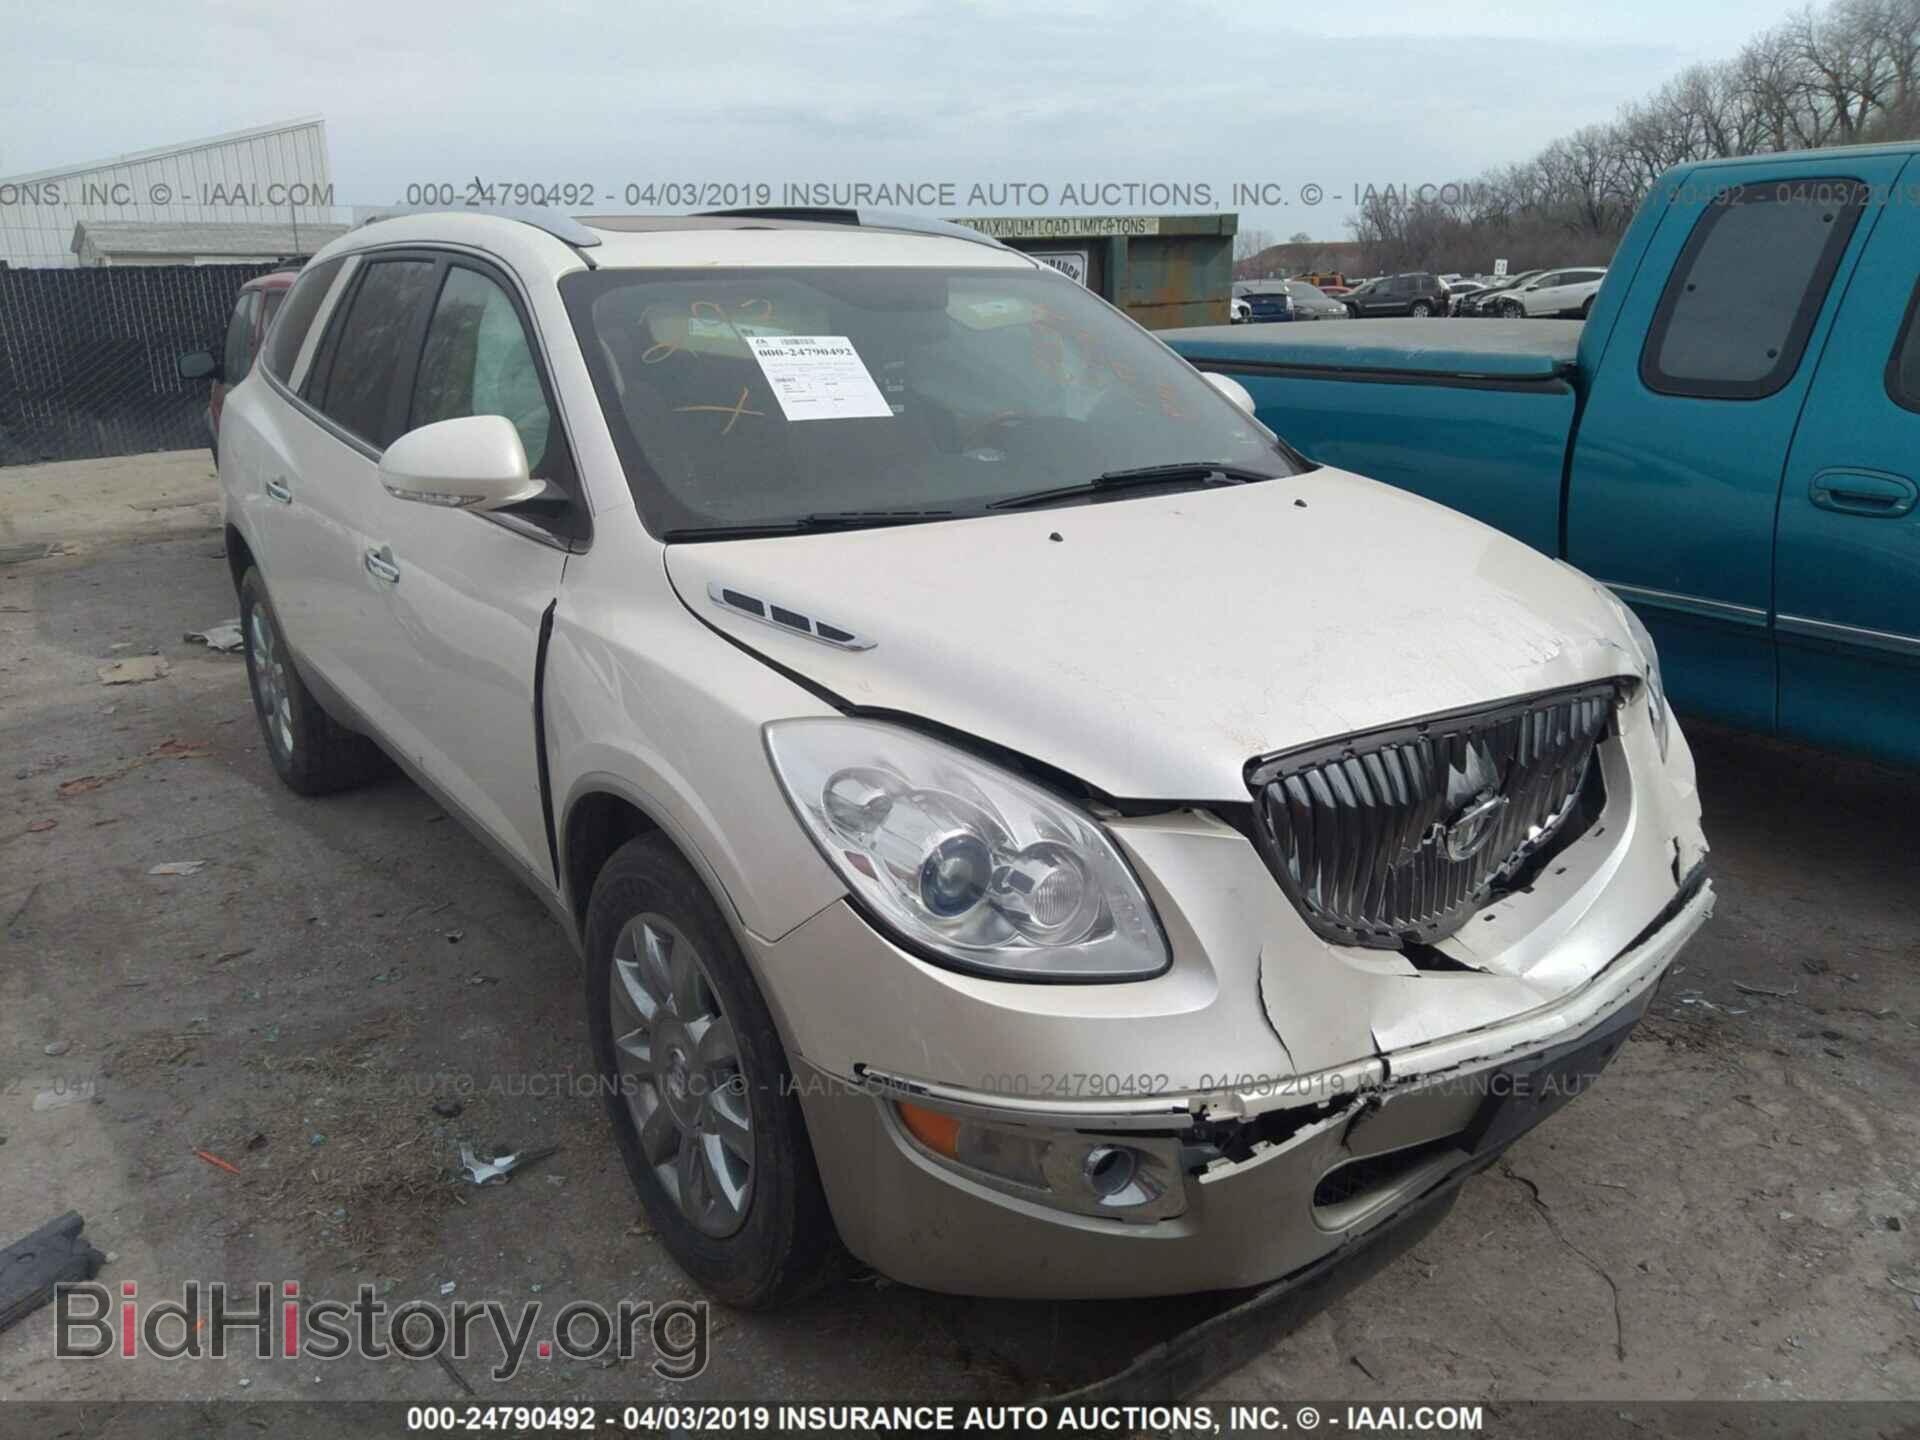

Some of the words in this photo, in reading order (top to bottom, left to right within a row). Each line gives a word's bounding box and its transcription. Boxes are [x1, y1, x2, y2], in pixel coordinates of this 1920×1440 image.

[974, 218, 1034, 236] MAXIMUM
[1039, 218, 1070, 235] LOAD
[757, 347, 854, 358] 000-24790492
